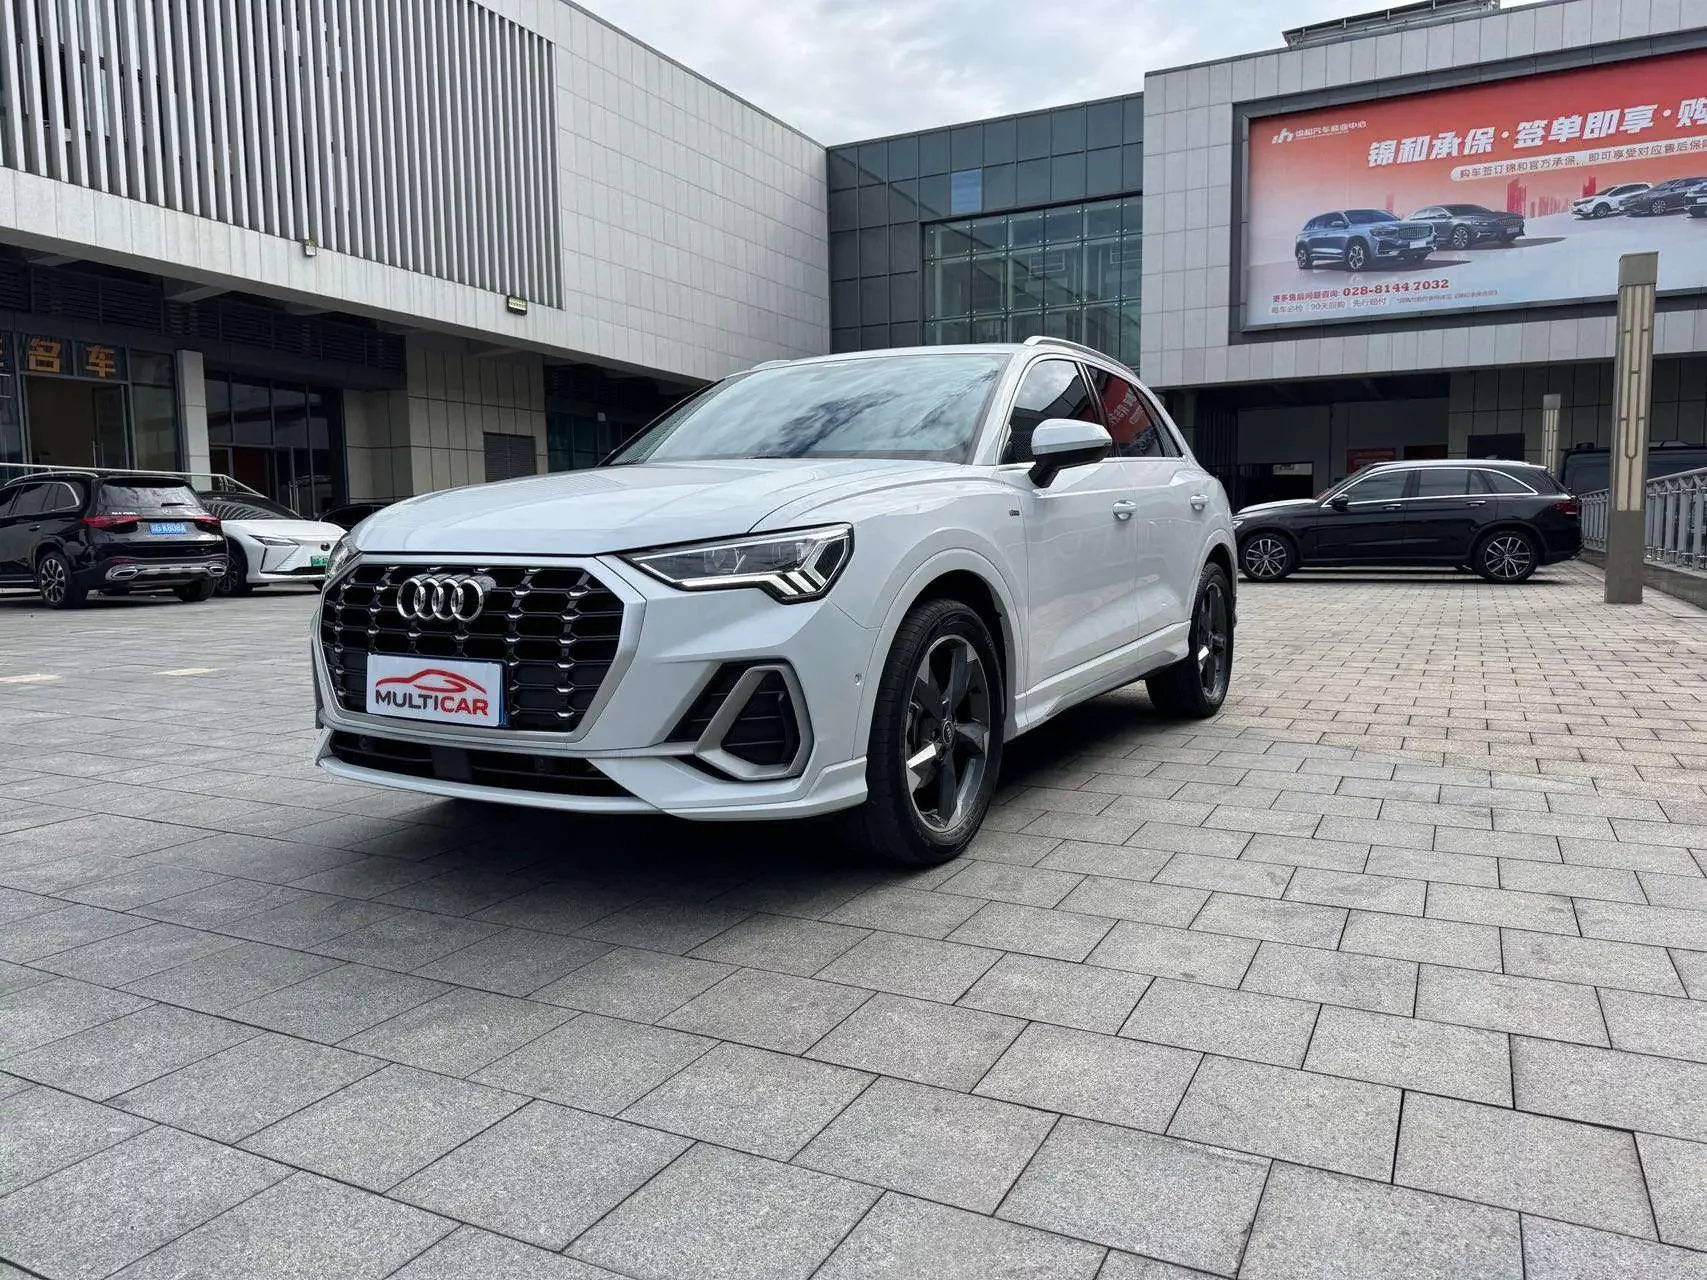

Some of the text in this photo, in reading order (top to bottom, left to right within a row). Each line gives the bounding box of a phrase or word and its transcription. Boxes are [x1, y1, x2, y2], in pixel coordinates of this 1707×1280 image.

[1343, 282, 1410, 297] 028-8144
[1413, 279, 1450, 292] 7032
[375, 689, 489, 716] MULTICAR
